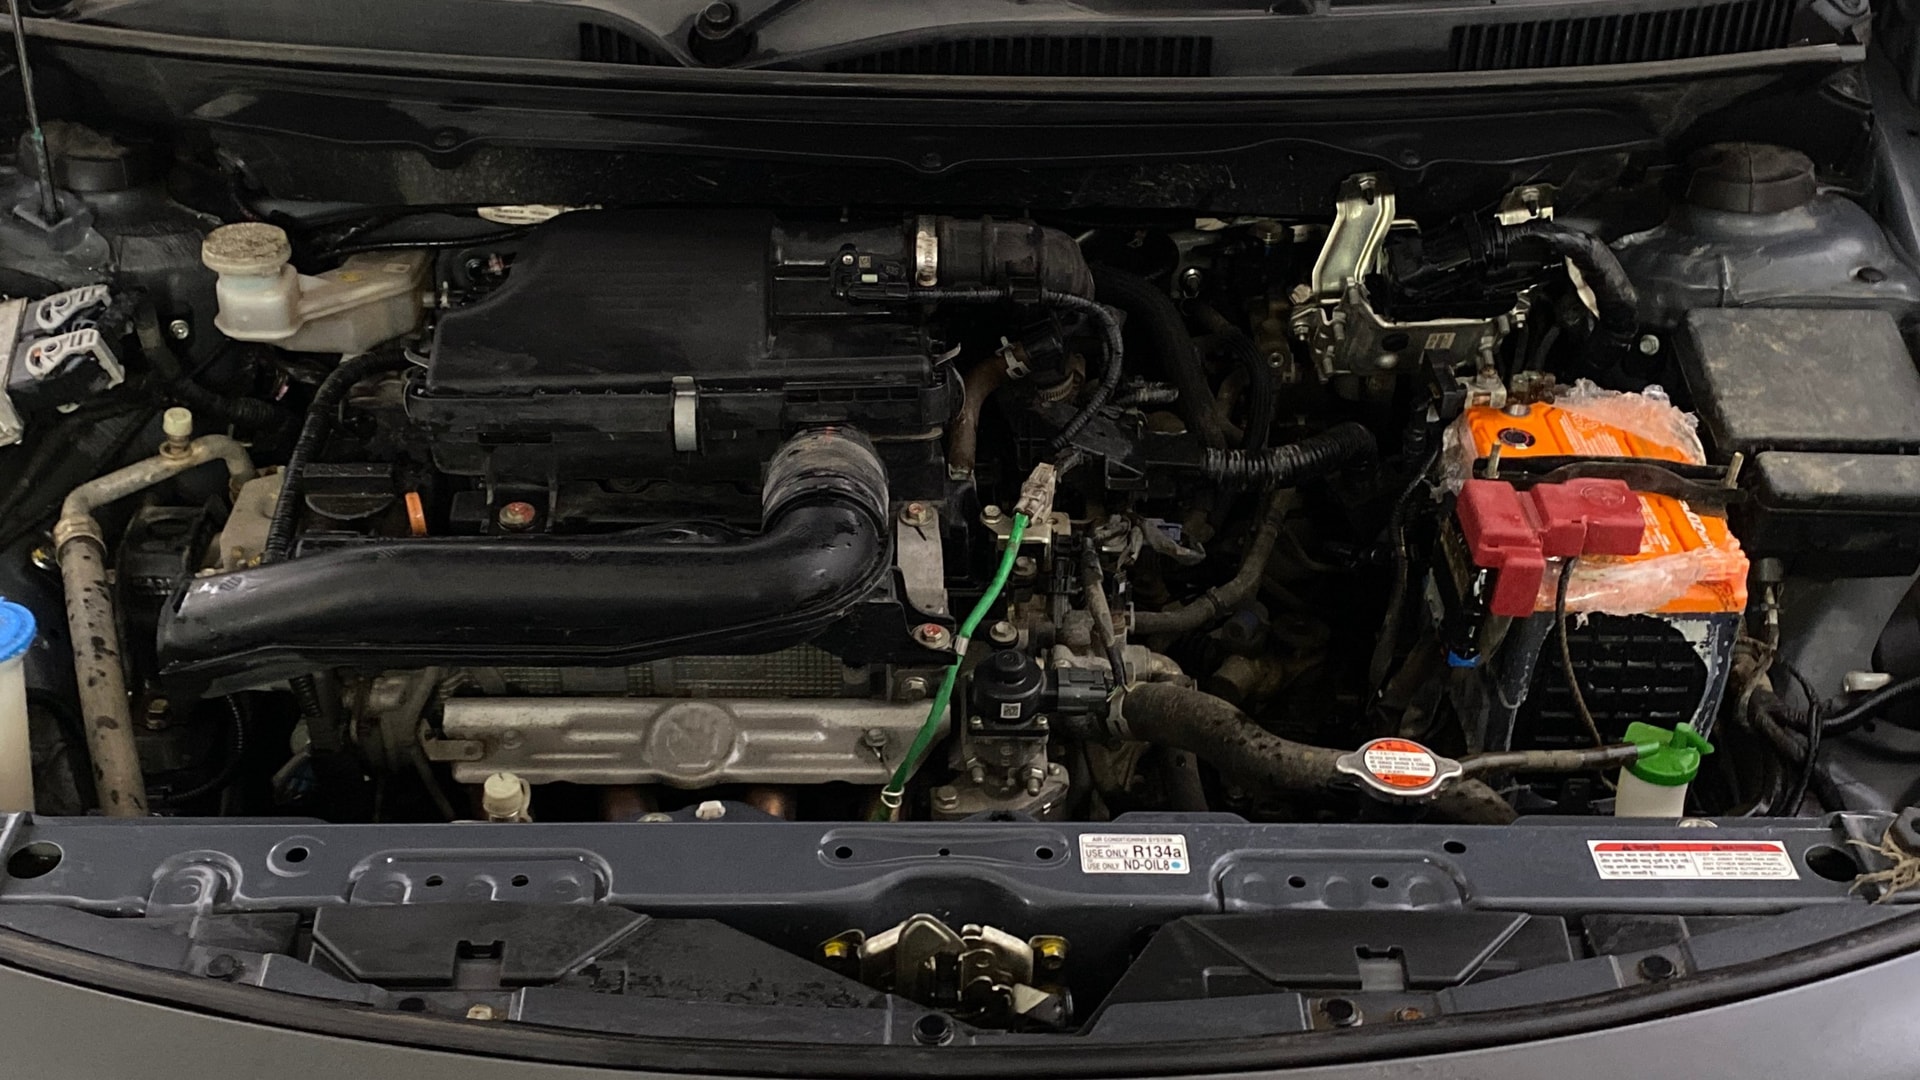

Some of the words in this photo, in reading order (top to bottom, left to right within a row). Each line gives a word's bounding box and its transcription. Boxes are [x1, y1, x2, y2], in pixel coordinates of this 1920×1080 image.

[1085, 849, 1103, 858] USE
[1105, 849, 1129, 858] ONLY
[1133, 845, 1182, 858] R134a
[1124, 860, 1170, 871] ND-OIL8
